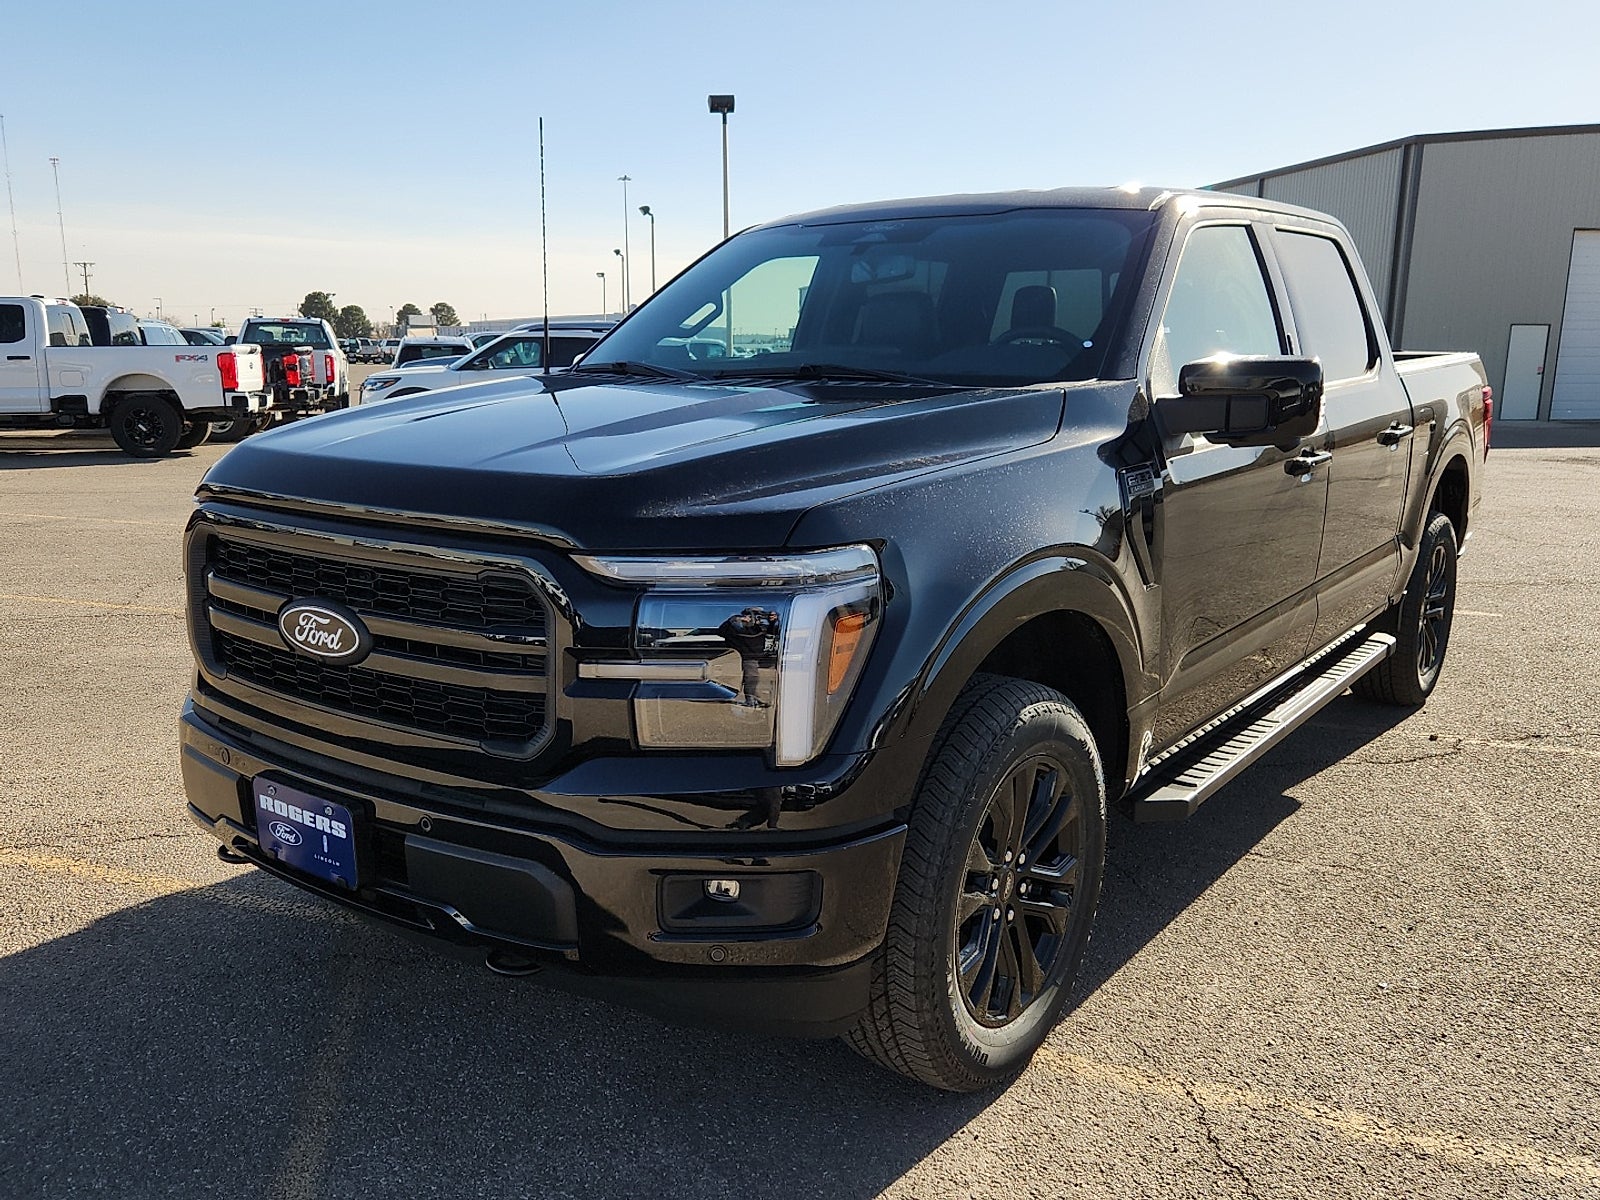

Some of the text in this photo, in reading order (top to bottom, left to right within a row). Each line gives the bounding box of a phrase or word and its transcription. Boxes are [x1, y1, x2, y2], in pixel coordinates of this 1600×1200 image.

[175, 354, 209, 362] FX4
[294, 612, 343, 650] Ford
[259, 794, 347, 839] ROGERS
[275, 823, 296, 843] Ford
[313, 853, 341, 867] LINCOLN
